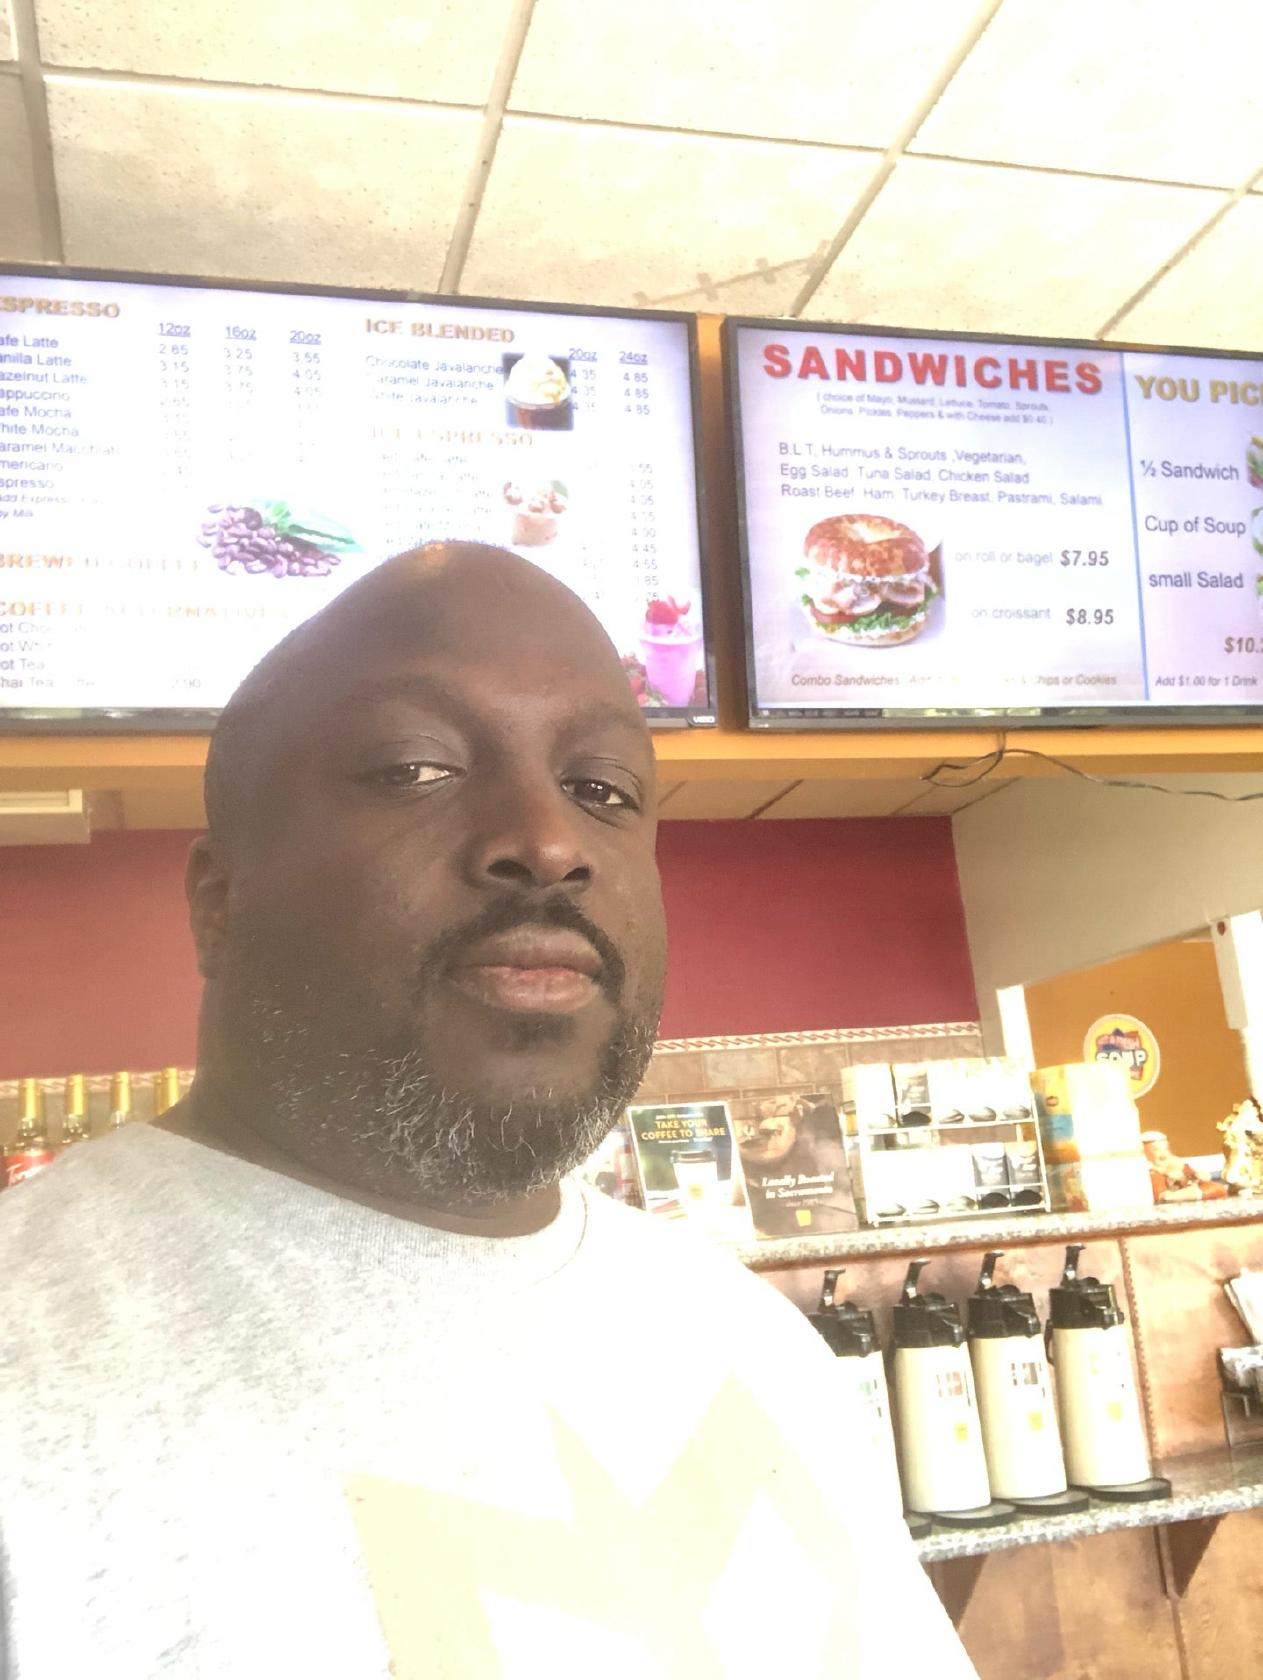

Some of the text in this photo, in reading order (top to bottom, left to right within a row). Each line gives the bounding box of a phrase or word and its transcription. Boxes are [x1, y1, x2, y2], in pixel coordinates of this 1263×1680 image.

[158, 322, 321, 345] 12oz 16oz 20oz
[365, 318, 515, 344] ICE BLENDED
[23, 335, 59, 349] Latte
[37, 354, 72, 367] Latte
[568, 347, 648, 366] 20oz 24oz
[365, 355, 503, 374] Chocolate Javalanche
[762, 343, 1103, 395] SANDWICHES
[53, 372, 88, 384] Latte
[426, 377, 495, 391] Javalanche
[822, 392, 853, 403] choice
[855, 393, 865, 403] of
[1135, 374, 1263, 407] YOU PIC
[24, 405, 72, 419] Mocha
[945, 411, 965, 421] with
[966, 411, 1001, 423] Cheese
[0, 423, 79, 437] hite Mocha
[821, 443, 881, 460] Hummus
[884, 446, 893, 459] &
[897, 446, 948, 464] Sprouts
[780, 463, 807, 479] Egg
[858, 466, 889, 480] Tuna
[937, 469, 990, 484] Chicken
[993, 471, 1031, 485] Salad
[1160, 459, 1240, 482] Sandwich
[780, 484, 821, 498] Roast
[902, 488, 945, 504] Turkey
[1144, 514, 1247, 538] Cup of Soup
[955, 549, 1110, 567] on roll or bagel $7.95
[1149, 571, 1245, 589] small Salad
[971, 607, 1115, 626] on croissant $8.95
[19, 658, 45, 671] Tea
[29, 677, 54, 689] Tea
[791, 673, 831, 687] Combo
[834, 674, 900, 687] Sandwiches
[1062, 677, 1074, 687] or
[1076, 674, 1118, 687] Cookies
[1154, 675, 1176, 687] Add
[1178, 674, 1206, 687] $1.00
[1207, 675, 1222, 687] for
[1231, 674, 1258, 688] Drink
[656, 1118, 708, 1130] TAKE YOUR
[641, 1129, 678, 1141] COFFEE
[679, 1129, 693, 1138] TO
